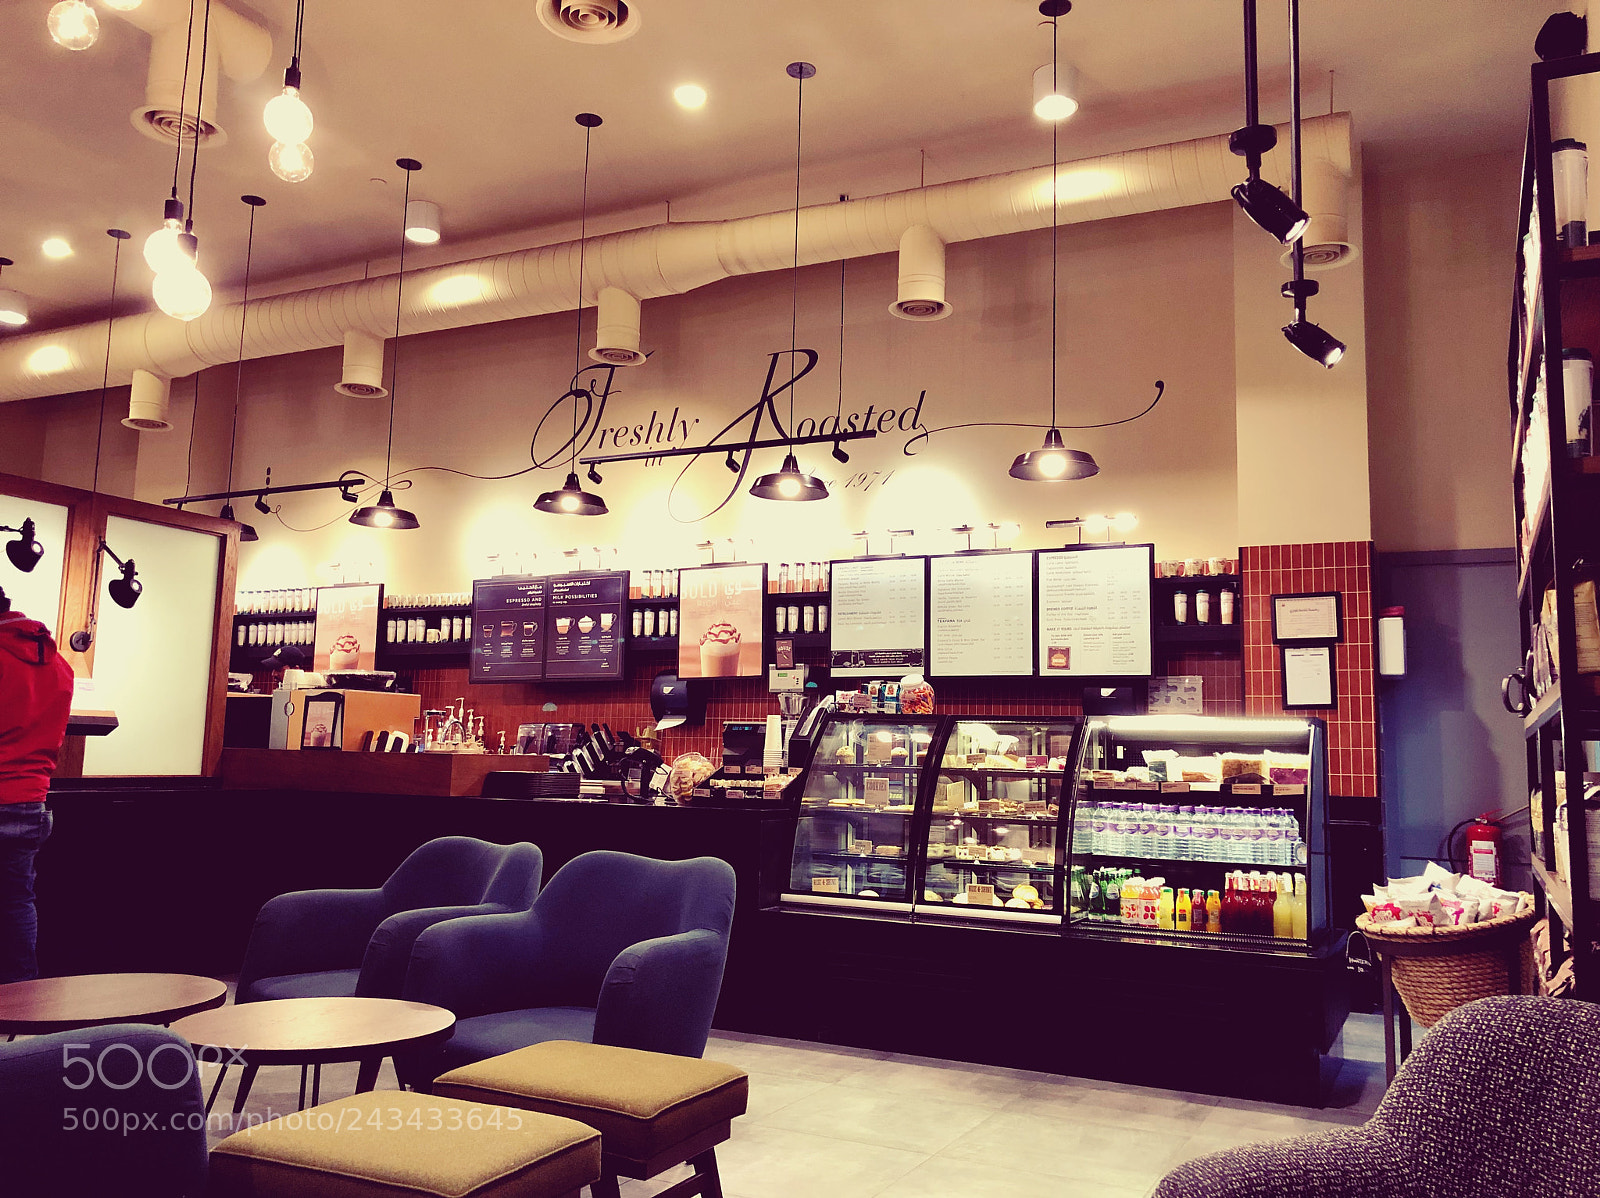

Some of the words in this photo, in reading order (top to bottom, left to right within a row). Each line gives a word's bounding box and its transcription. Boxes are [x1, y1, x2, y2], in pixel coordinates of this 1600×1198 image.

[531, 350, 700, 469] Freshly
[668, 348, 928, 523] Roasted
[843, 468, 896, 492] 1971
